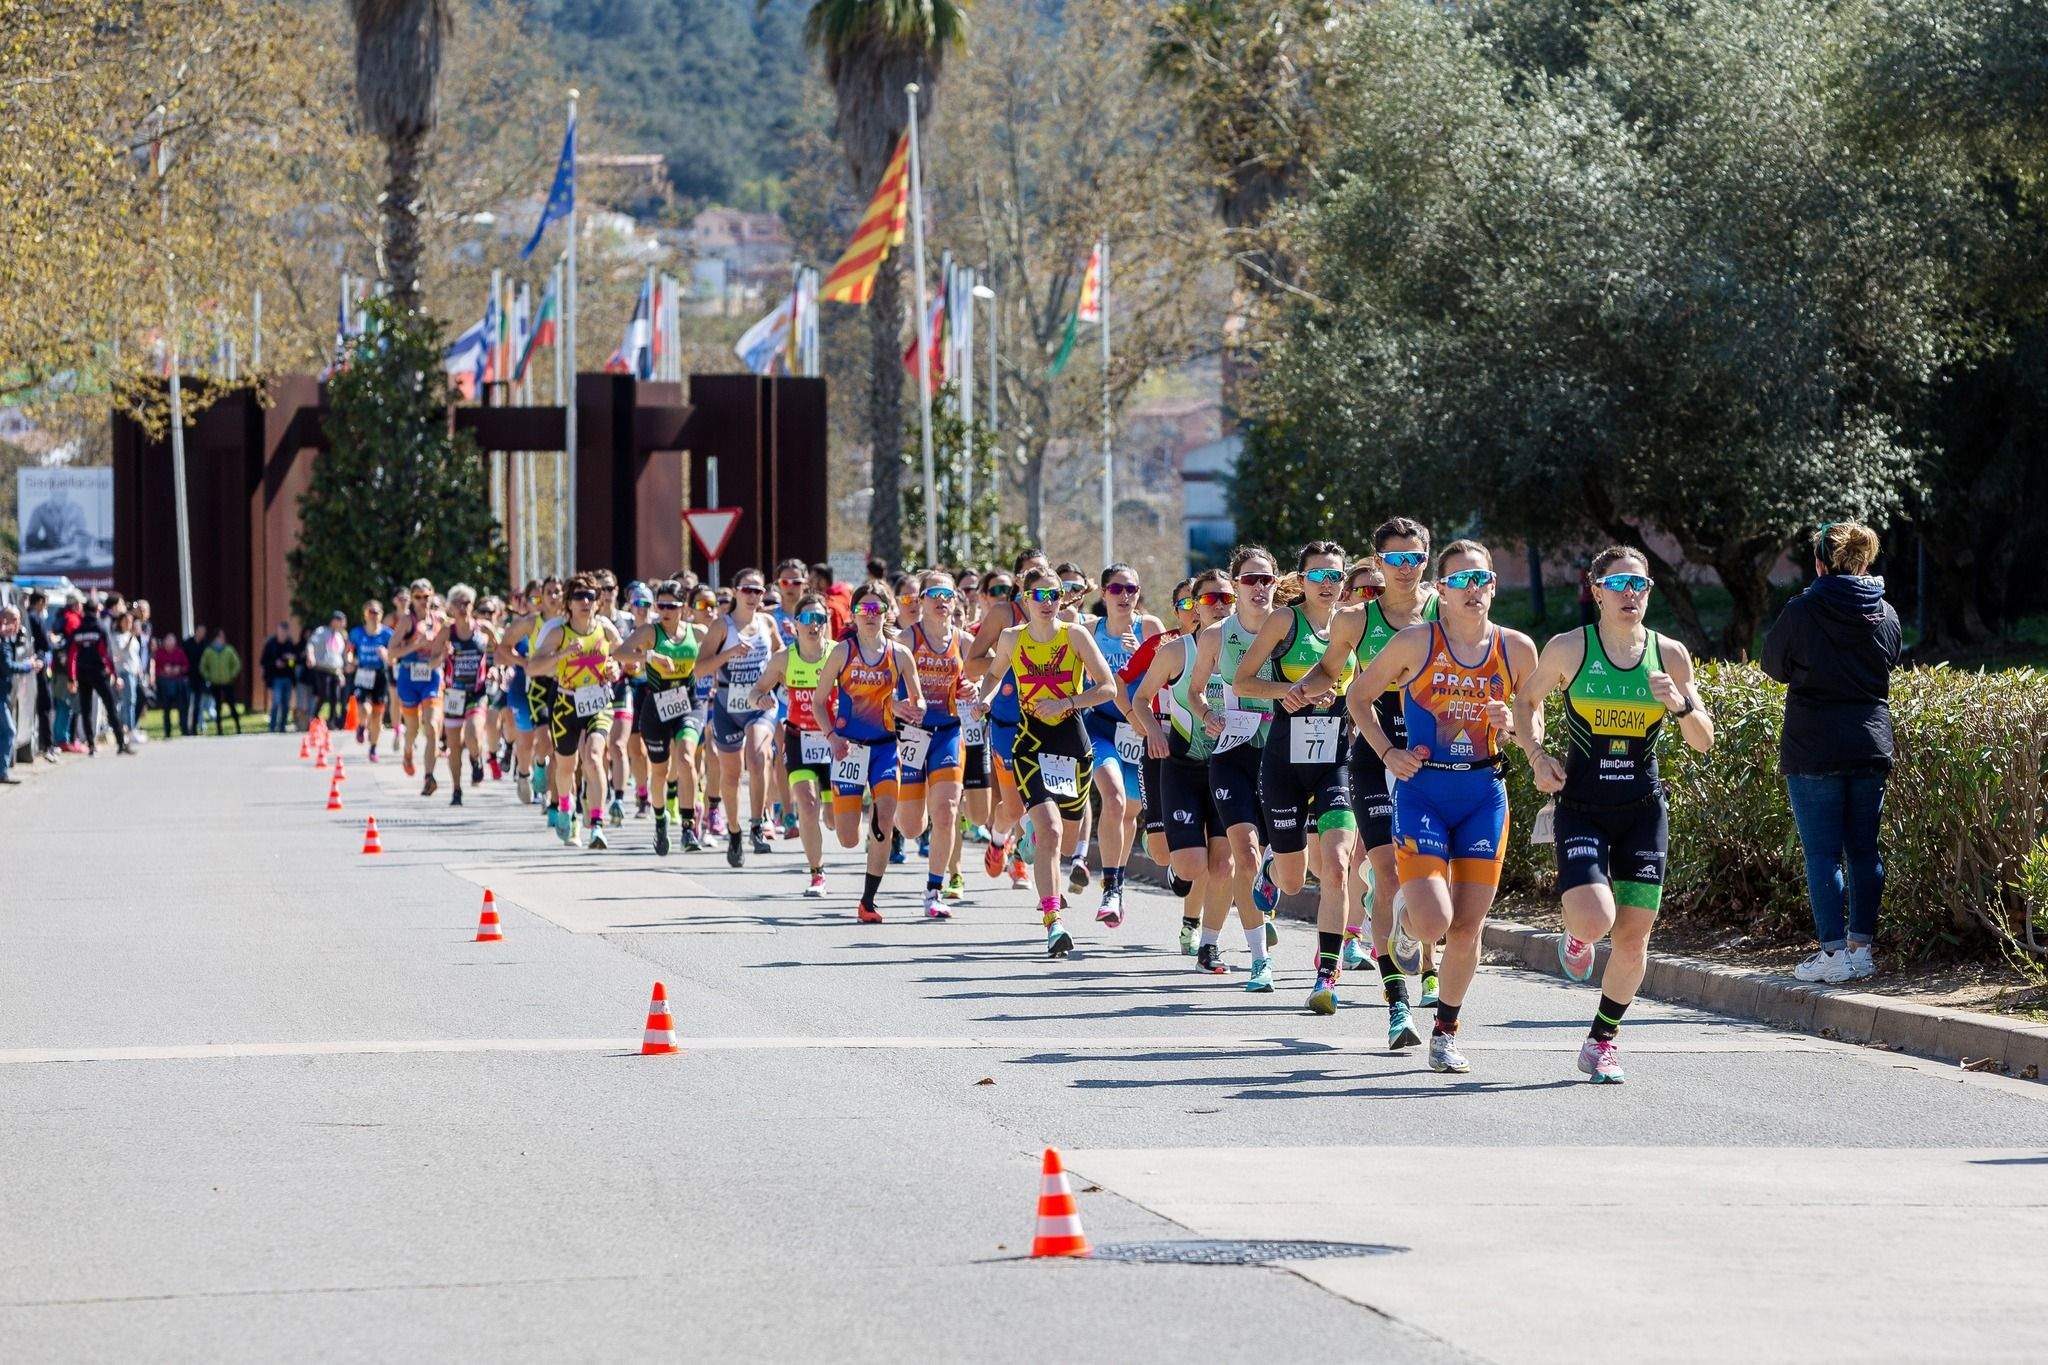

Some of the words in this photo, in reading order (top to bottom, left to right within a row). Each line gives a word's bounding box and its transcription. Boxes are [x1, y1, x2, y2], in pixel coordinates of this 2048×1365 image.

[919, 656, 950, 666] PRAT
[851, 669, 883, 680] PRAT
[1432, 672, 1488, 690] PRAT
[1586, 682, 1647, 697] KATO
[660, 700, 689, 718] 1088
[1594, 708, 1646, 730] BURGAYA
[1305, 739, 1325, 759] 77
[1450, 744, 1474, 754] SBR
[838, 760, 861, 780] 206
[1368, 805, 1393, 816] 226ER
